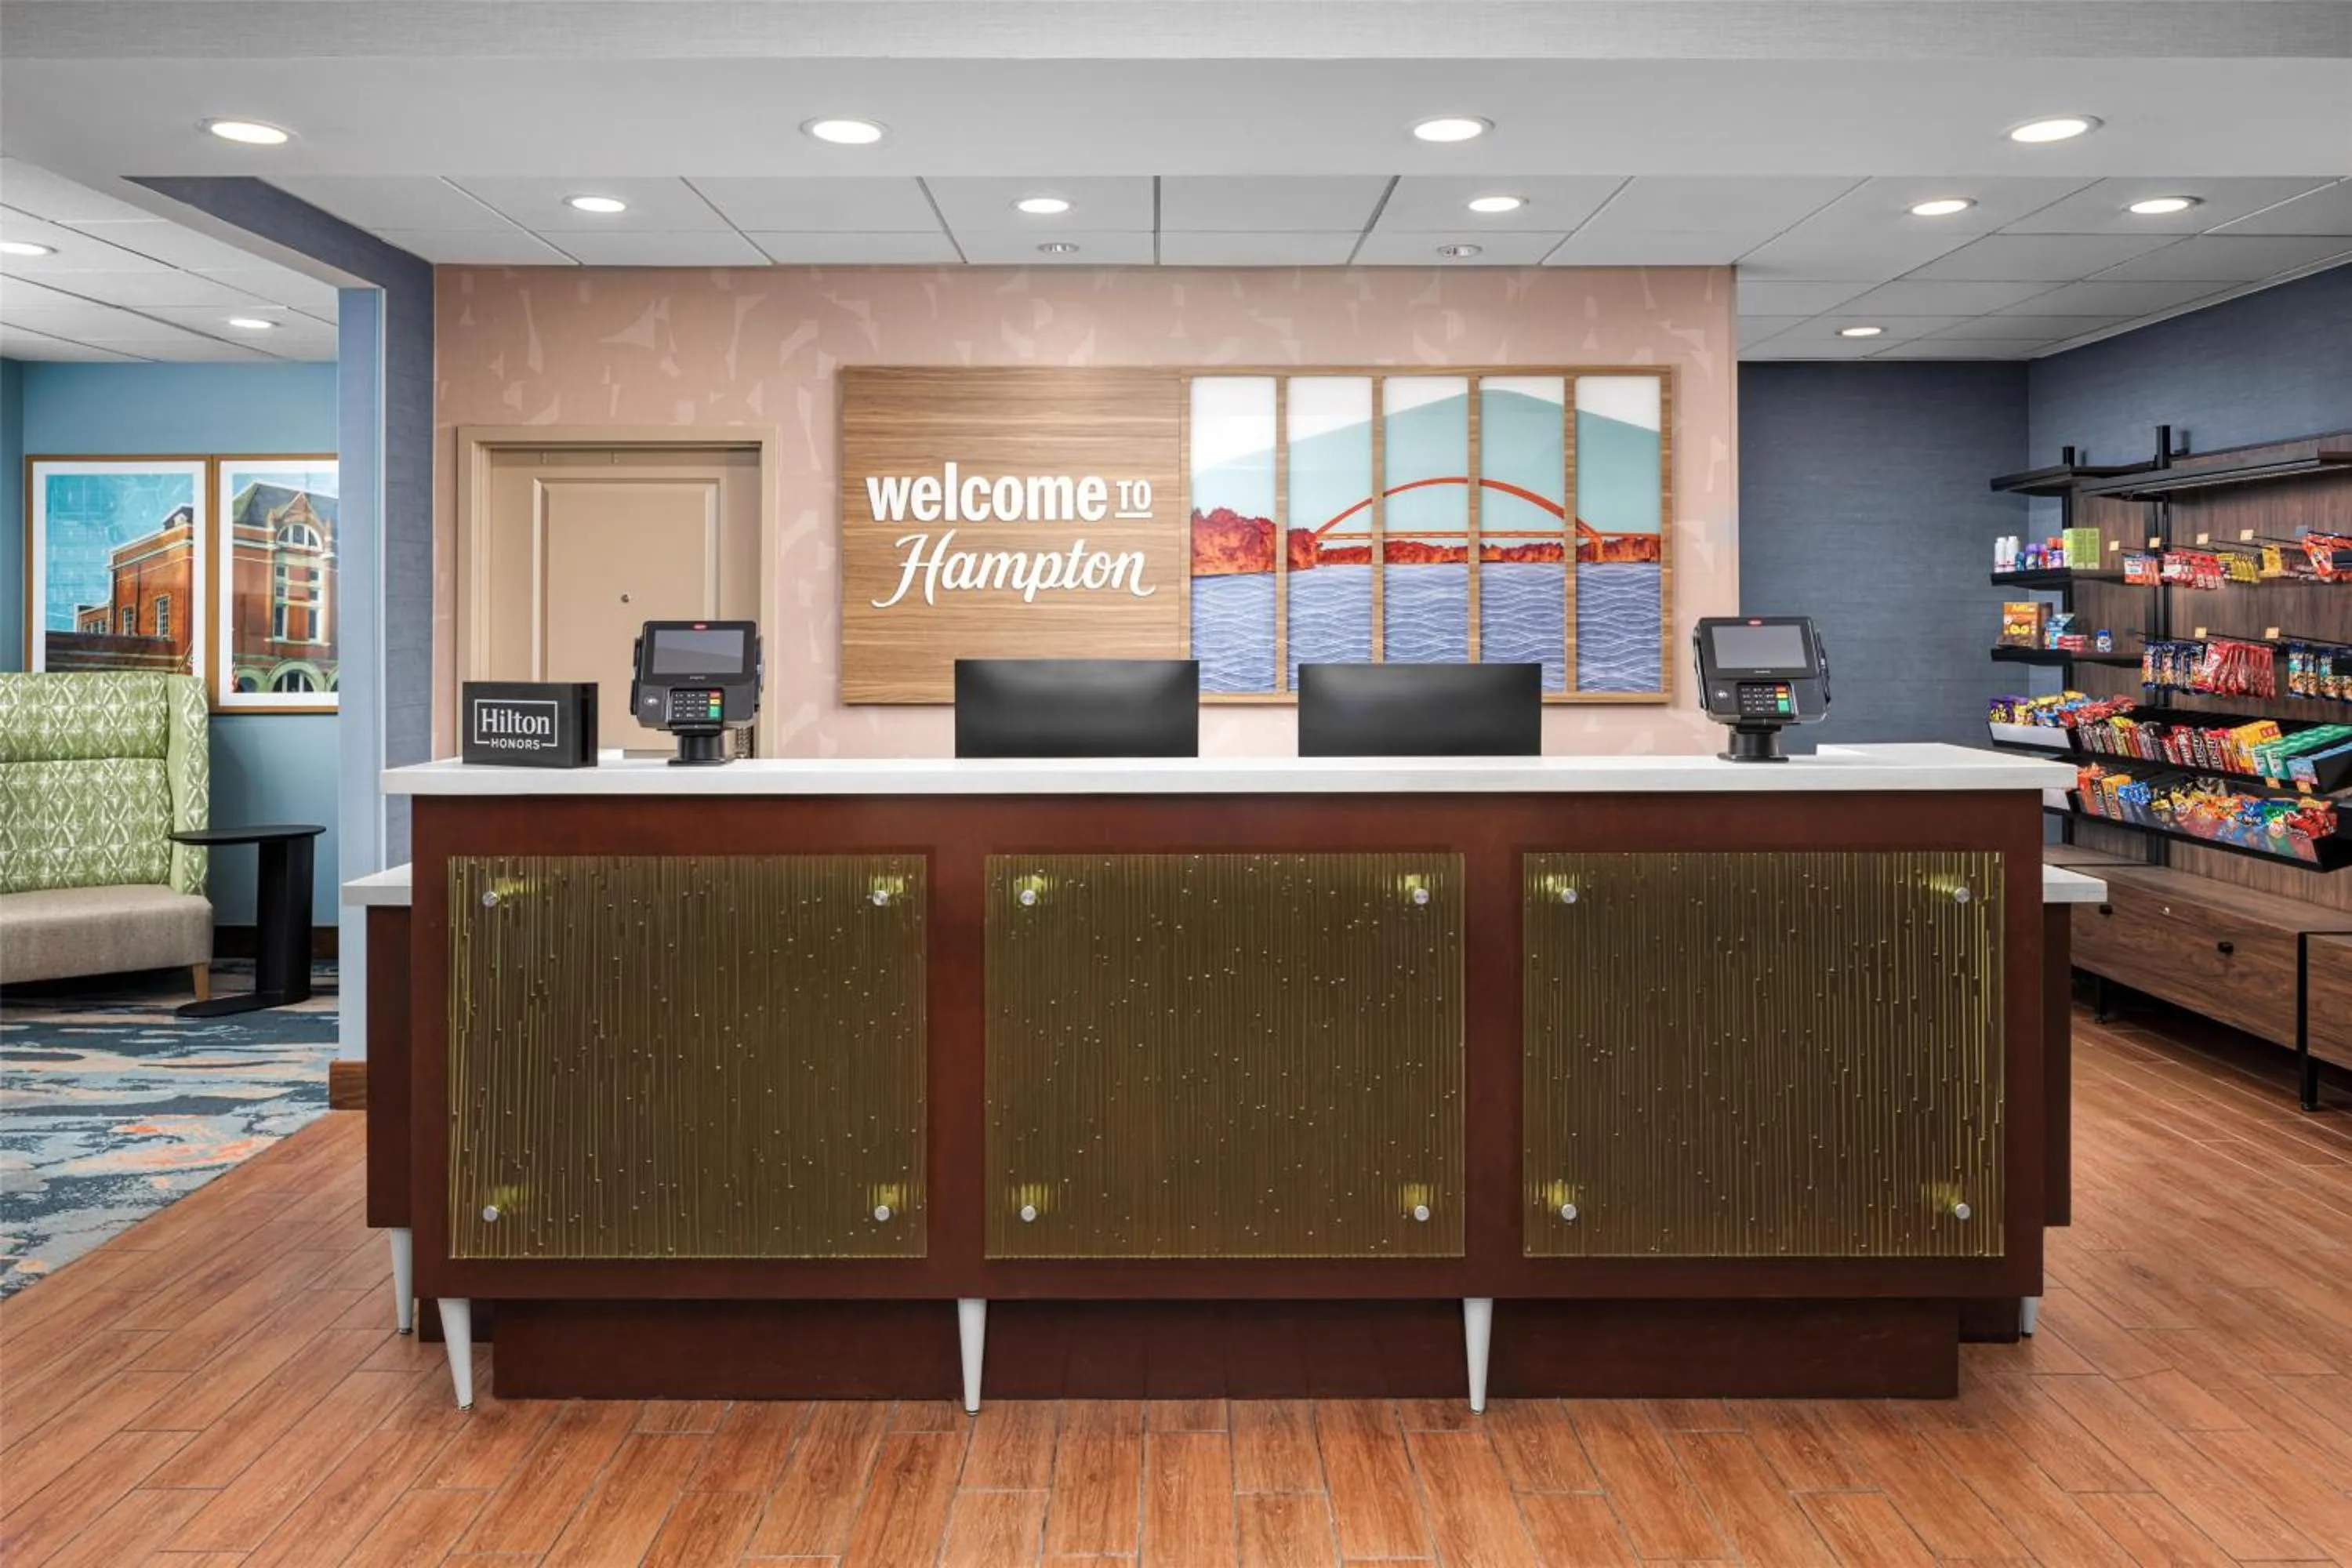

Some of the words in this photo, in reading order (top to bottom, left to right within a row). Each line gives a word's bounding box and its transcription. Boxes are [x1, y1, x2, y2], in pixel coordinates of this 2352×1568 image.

[866, 462, 1109, 522] welcome
[1116, 480, 1152, 510] TO
[871, 528, 1156, 608] Hampton
[481, 708, 550, 735] Hilton
[491, 738, 540, 750] HONORS
